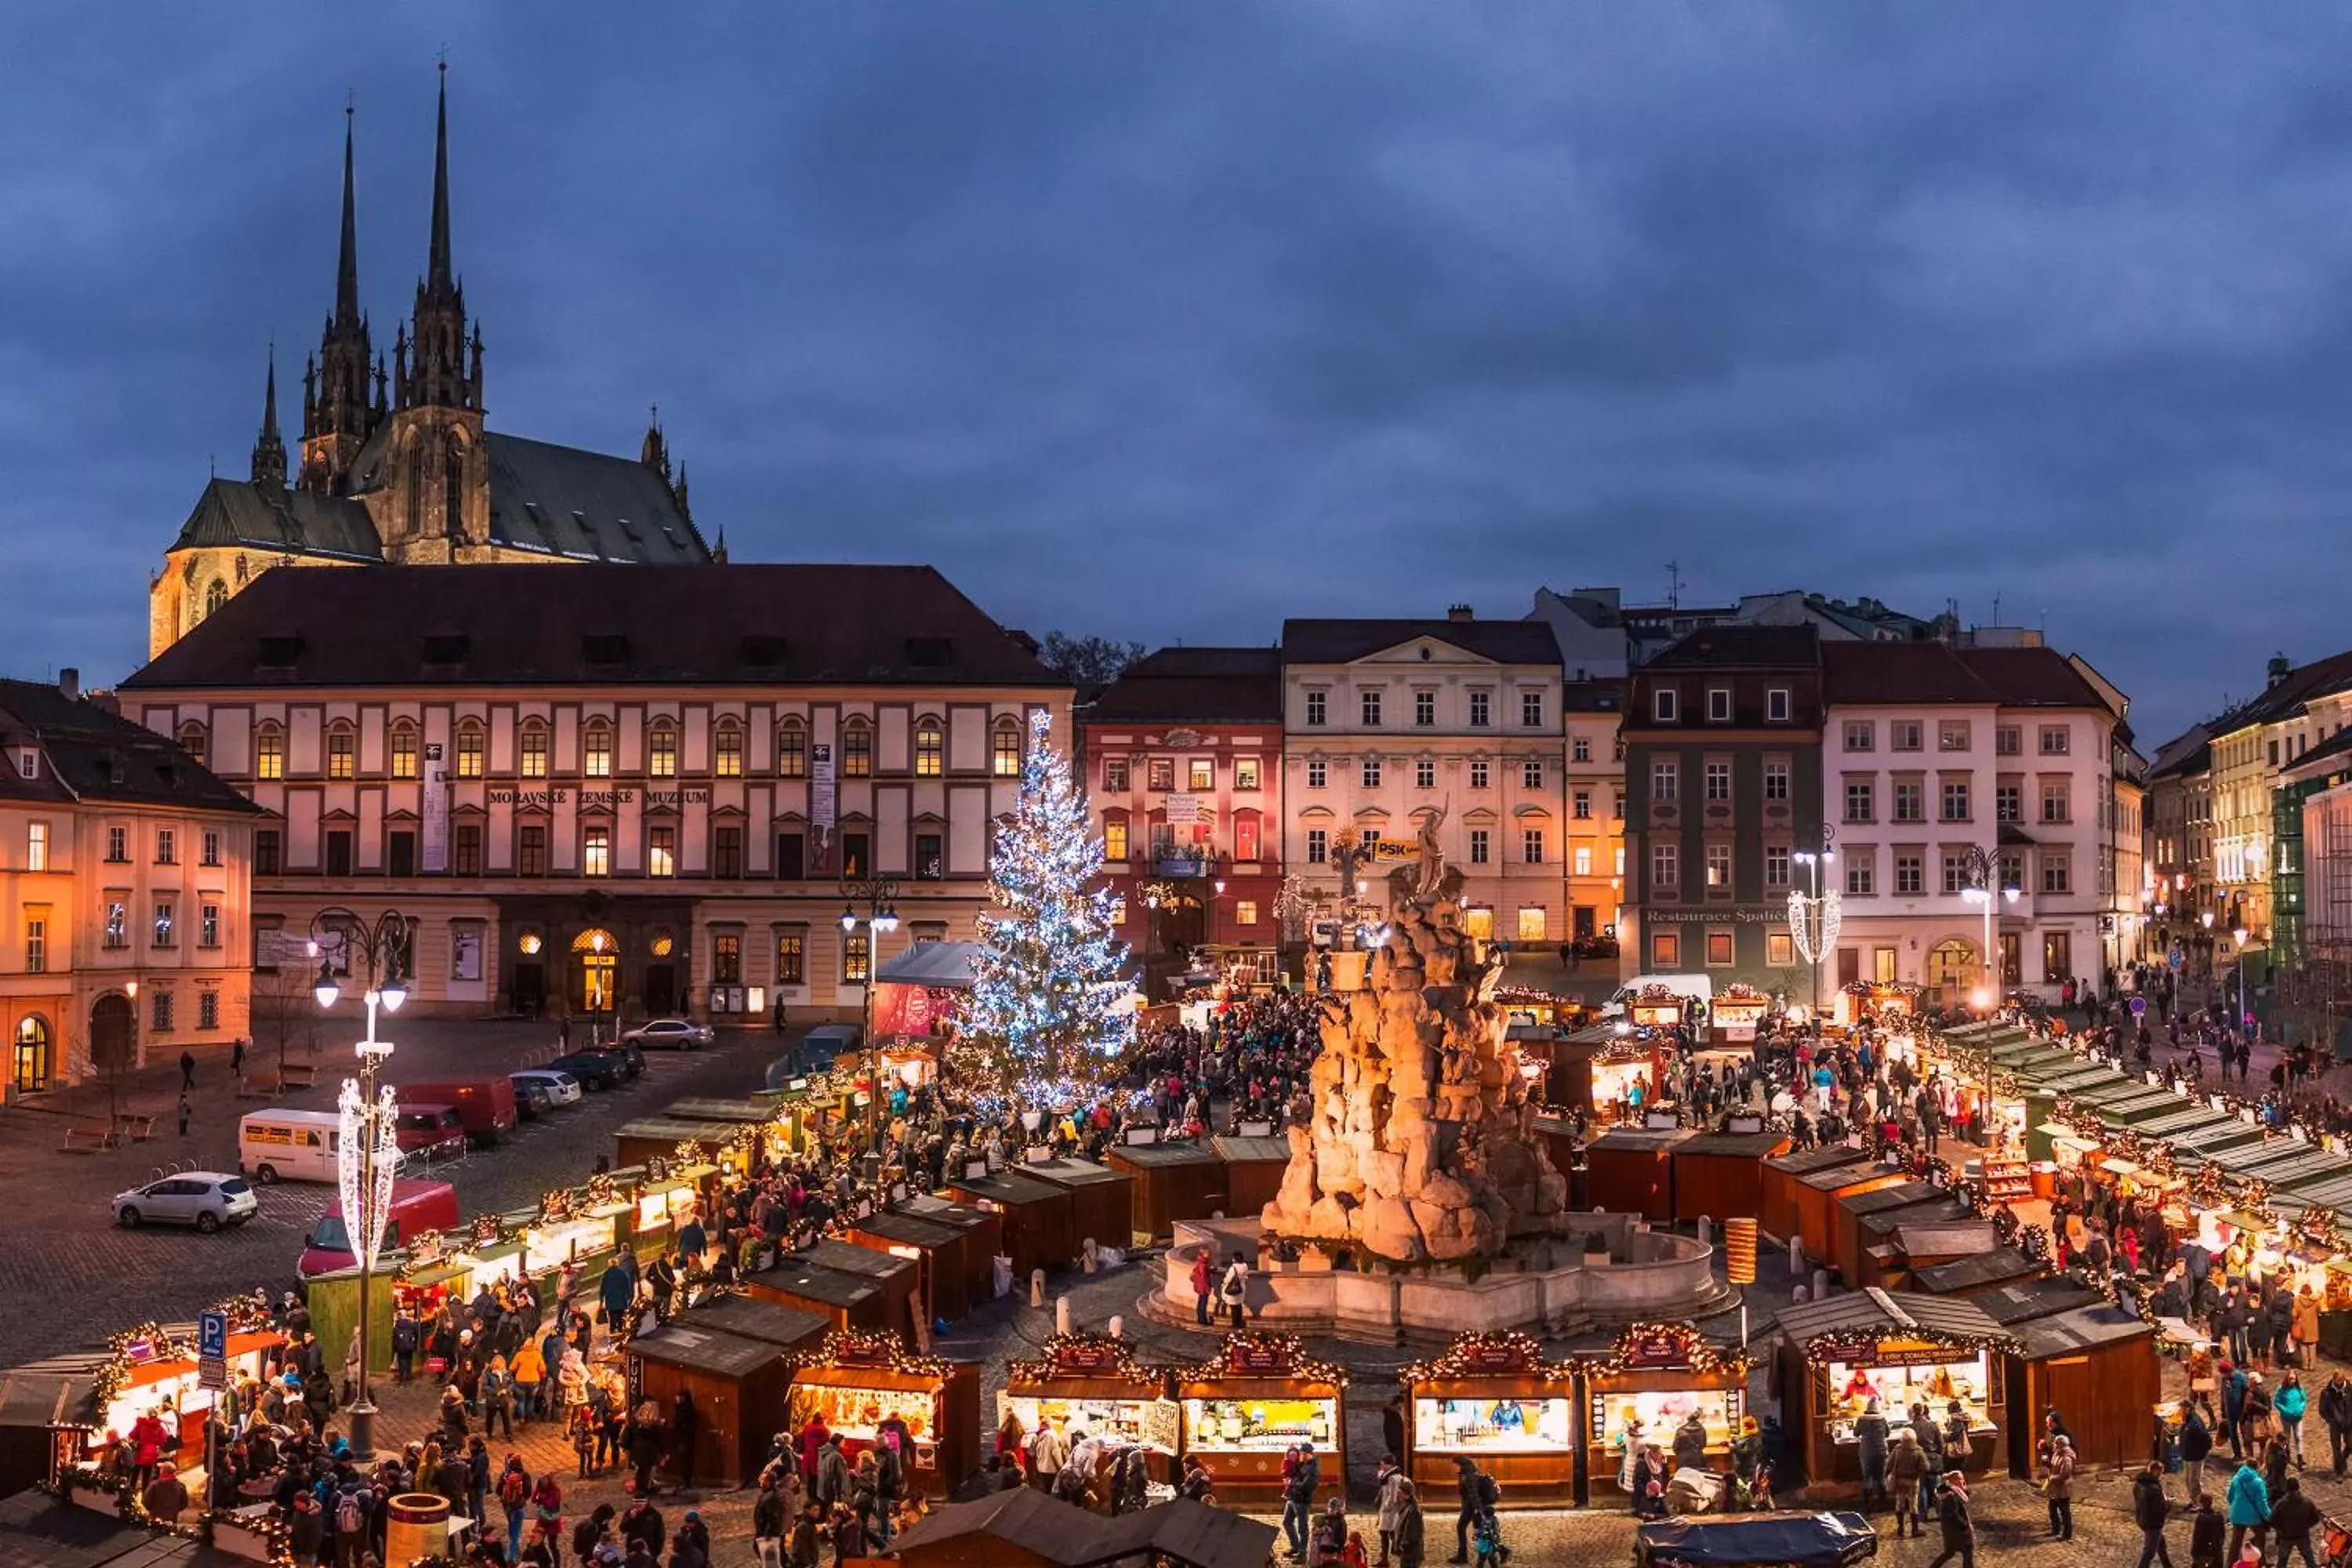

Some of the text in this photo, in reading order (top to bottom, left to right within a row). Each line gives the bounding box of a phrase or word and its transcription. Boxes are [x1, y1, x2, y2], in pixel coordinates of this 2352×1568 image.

[646, 791, 707, 803] MUZEUM
[1379, 843, 1406, 855] PSK
[1648, 909, 1731, 922] Restaurace
[205, 1318, 220, 1343] P
